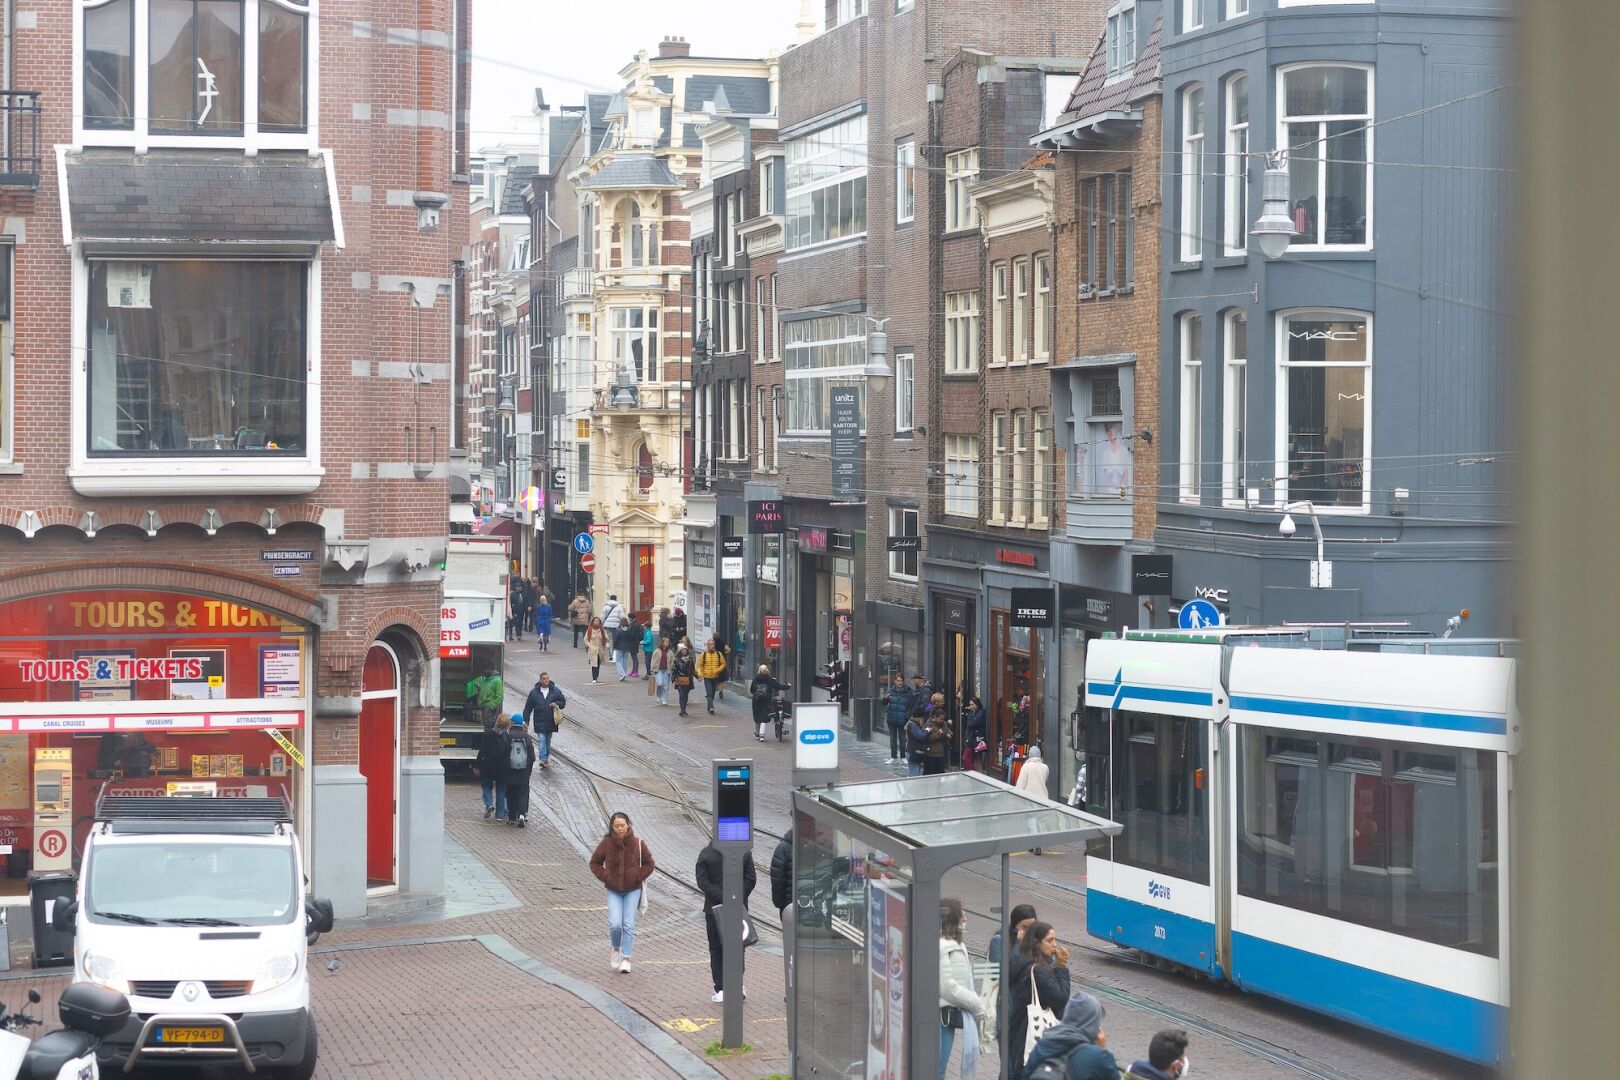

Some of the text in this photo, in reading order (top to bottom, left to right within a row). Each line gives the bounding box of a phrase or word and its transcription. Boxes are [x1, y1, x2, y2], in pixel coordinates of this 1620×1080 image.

[835, 394, 855, 402] unitz
[762, 502, 776, 511] ICI
[755, 512, 782, 521] PARIS
[263, 551, 312, 560] PRINSENGRACHT
[274, 567, 300, 575] CENTRUM
[70, 601, 165, 628] TOURS
[175, 600, 198, 628] &
[448, 648, 467, 656] ATM
[19, 658, 91, 682] TOURS
[95, 659, 113, 681] &
[117, 656, 203, 680] TICKETS
[43, 720, 61, 728] CANAL
[145, 718, 174, 726] MUSEUMS
[236, 716, 273, 724] ATTRACTIONS
[1159, 885, 1171, 900] GVB
[166, 1030, 220, 1041] YF-794-D
